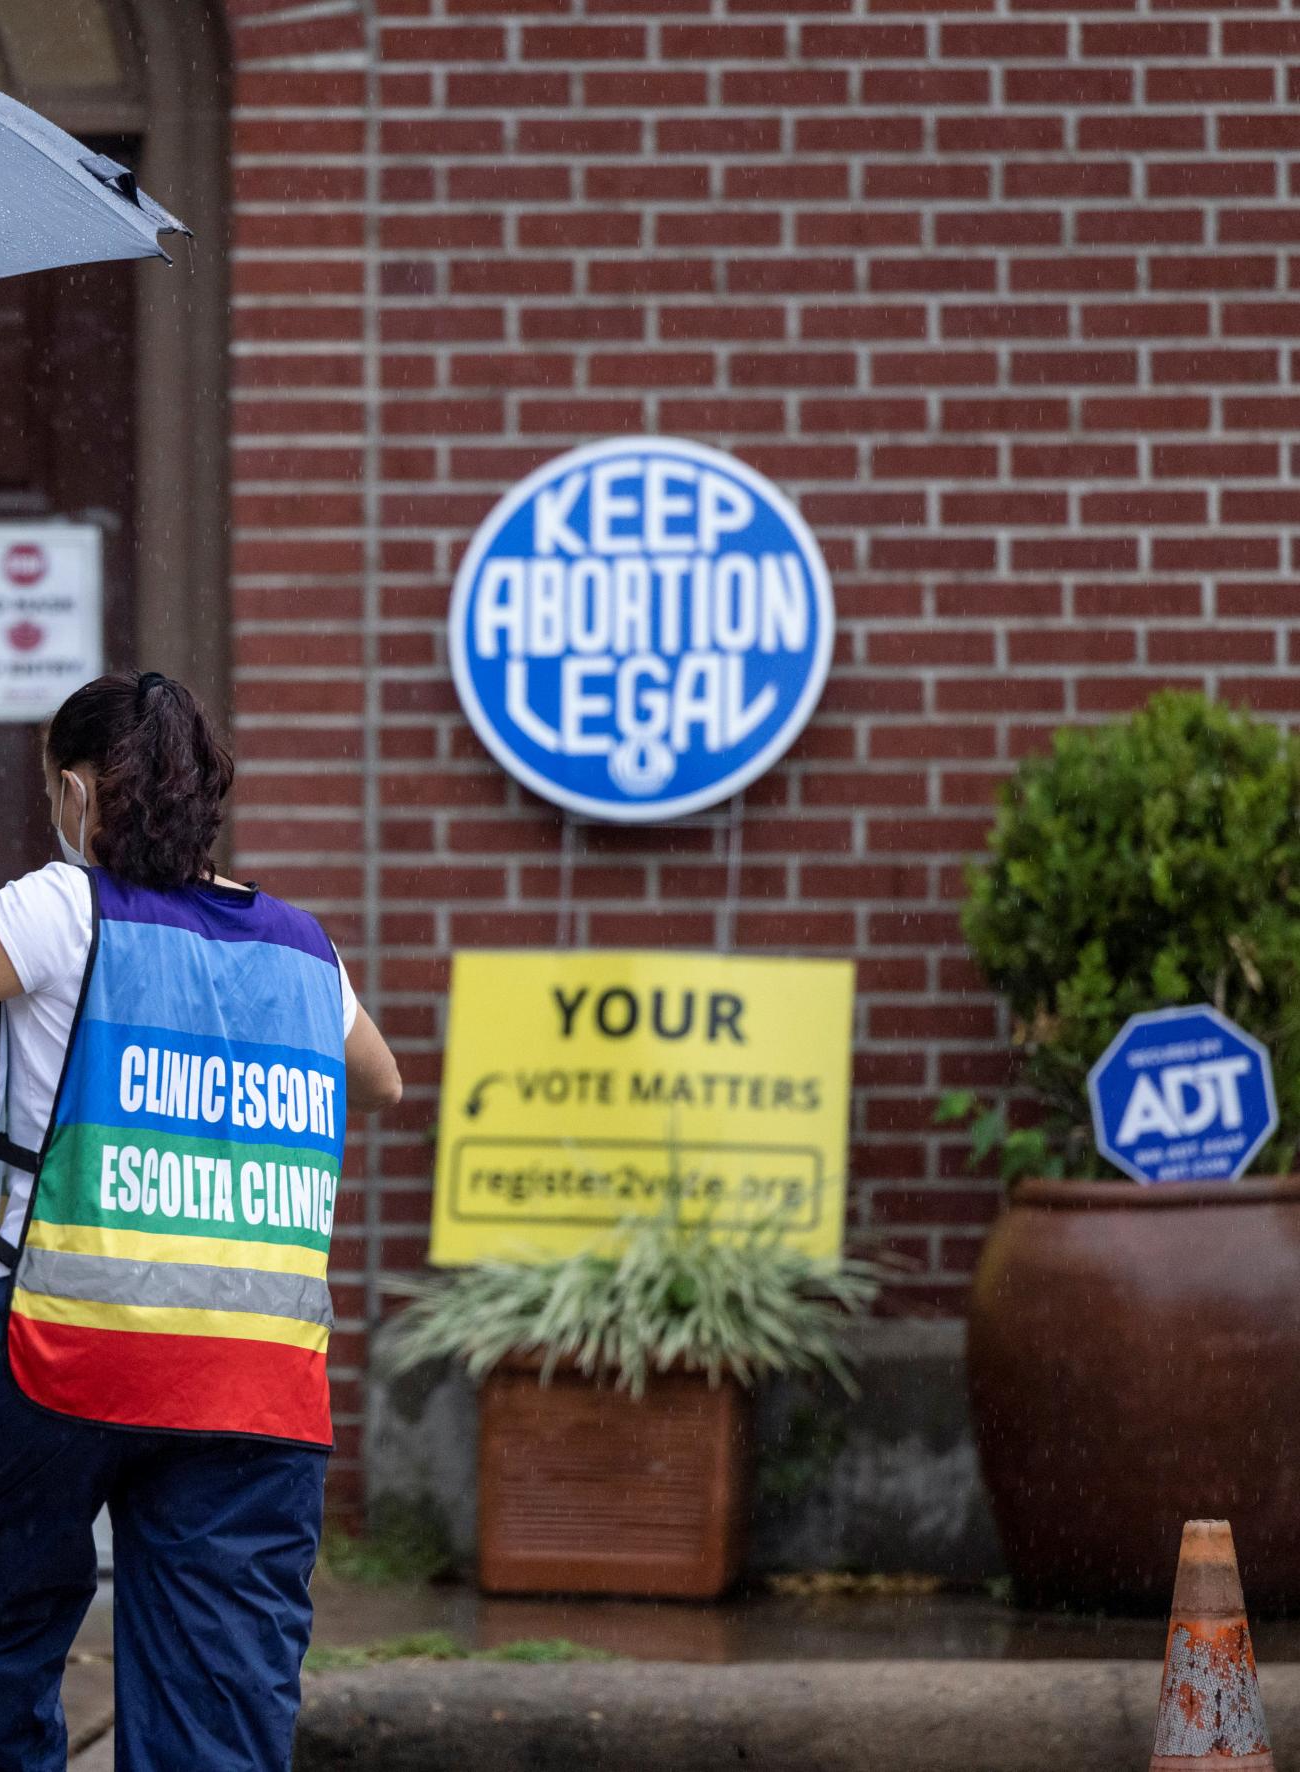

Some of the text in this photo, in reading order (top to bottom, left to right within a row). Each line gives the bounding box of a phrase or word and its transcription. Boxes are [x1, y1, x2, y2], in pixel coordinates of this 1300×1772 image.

[534, 459, 756, 557] KEEP
[475, 553, 808, 659] ABORTION
[505, 650, 778, 755] LEGAL
[552, 985, 747, 1044] YOUR
[120, 1045, 335, 1139] CLINIC ESCORT
[515, 1068, 821, 1112] VOTE MATTERS
[1115, 1054, 1250, 1146] ADT
[100, 1145, 338, 1237] ESCOLTA CLINIC
